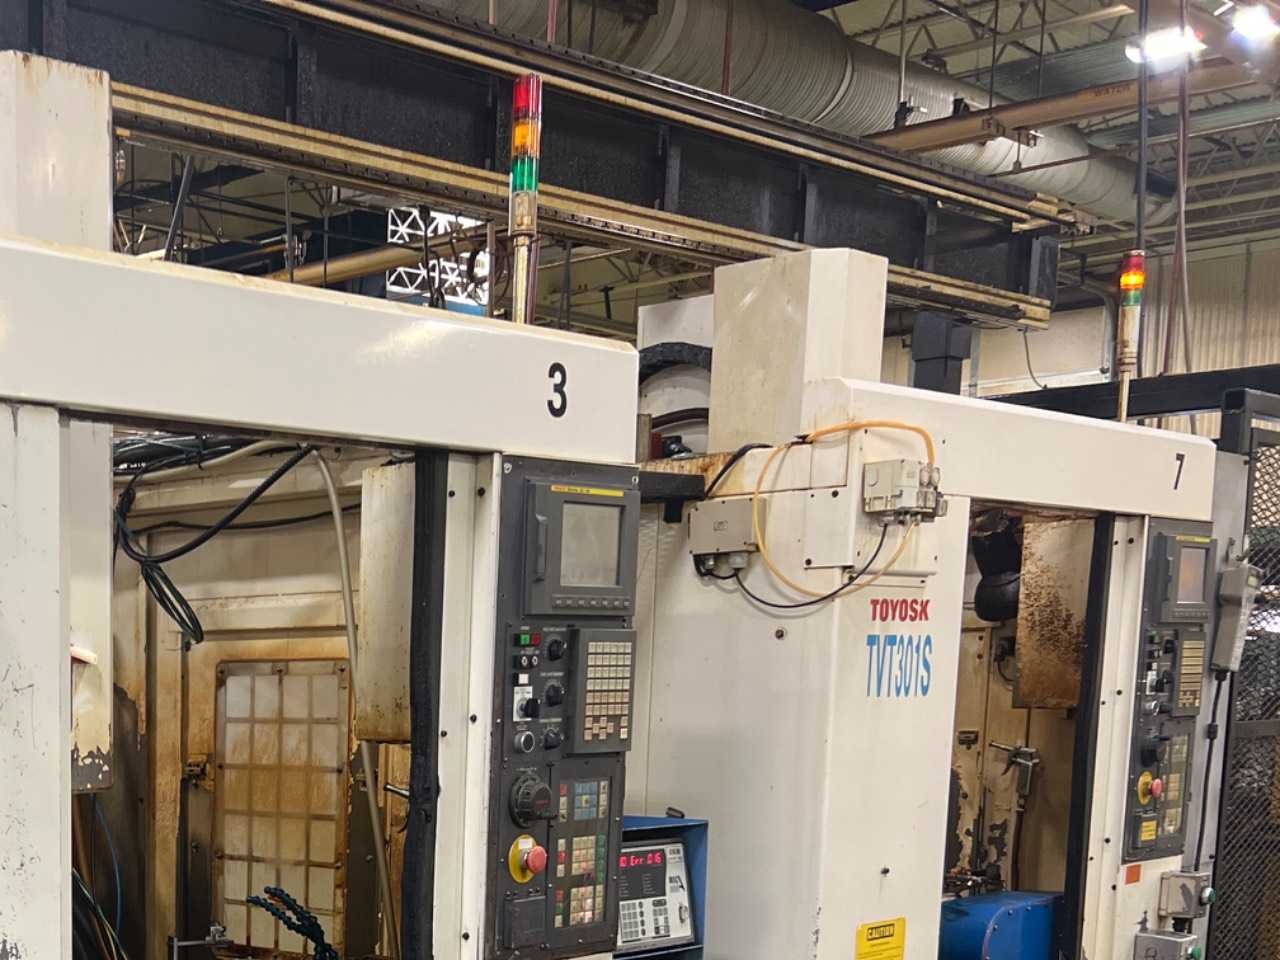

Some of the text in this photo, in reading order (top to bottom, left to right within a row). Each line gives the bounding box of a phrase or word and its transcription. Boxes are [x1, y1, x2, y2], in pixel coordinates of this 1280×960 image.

[547, 361, 567, 418] 3
[1174, 453, 1186, 490] 7
[870, 598, 930, 622] TOYOSK
[866, 634, 933, 698] TVT301S
